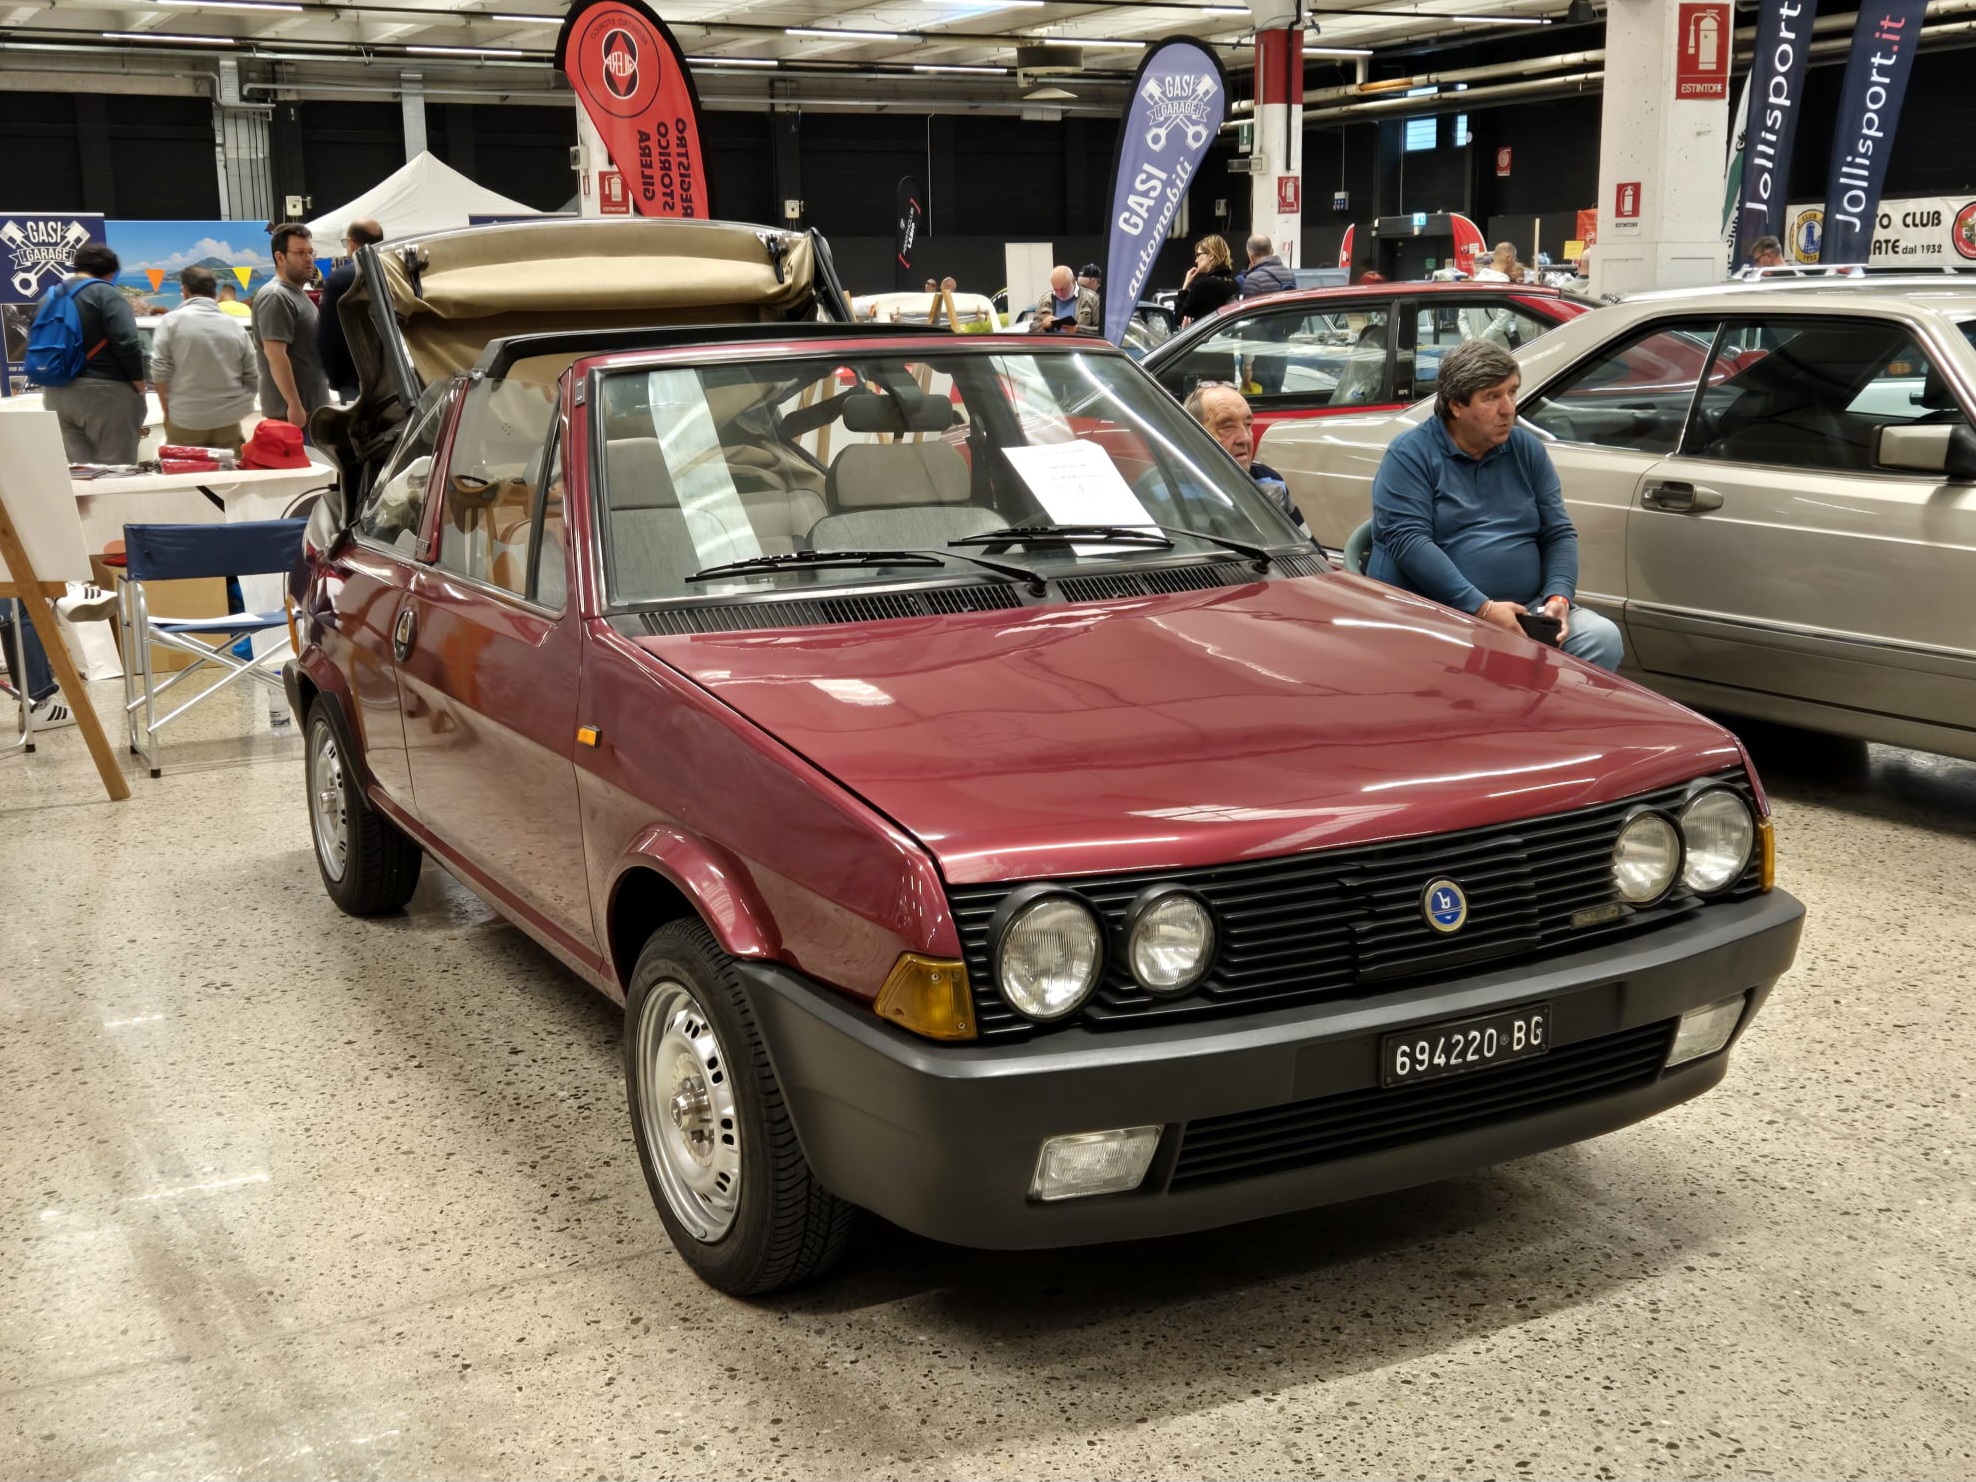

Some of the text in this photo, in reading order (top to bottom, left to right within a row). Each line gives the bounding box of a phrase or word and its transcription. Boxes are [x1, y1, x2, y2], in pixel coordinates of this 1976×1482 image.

[1165, 75, 1194, 98] GASI
[1681, 83, 1723, 94] ESTINTORE
[1161, 102, 1197, 116] GARAGE
[1835, 15, 1905, 233] Jollisport.it
[1118, 163, 1168, 236] GASI
[1128, 156, 1193, 301] automobili
[1902, 210, 1942, 229] CLUB
[26, 221, 61, 243] GASI
[26, 249, 69, 261] GARAGE
[1869, 239, 1943, 256] ATE dal 1932
[1396, 1016, 1543, 1076] 694220 BG
